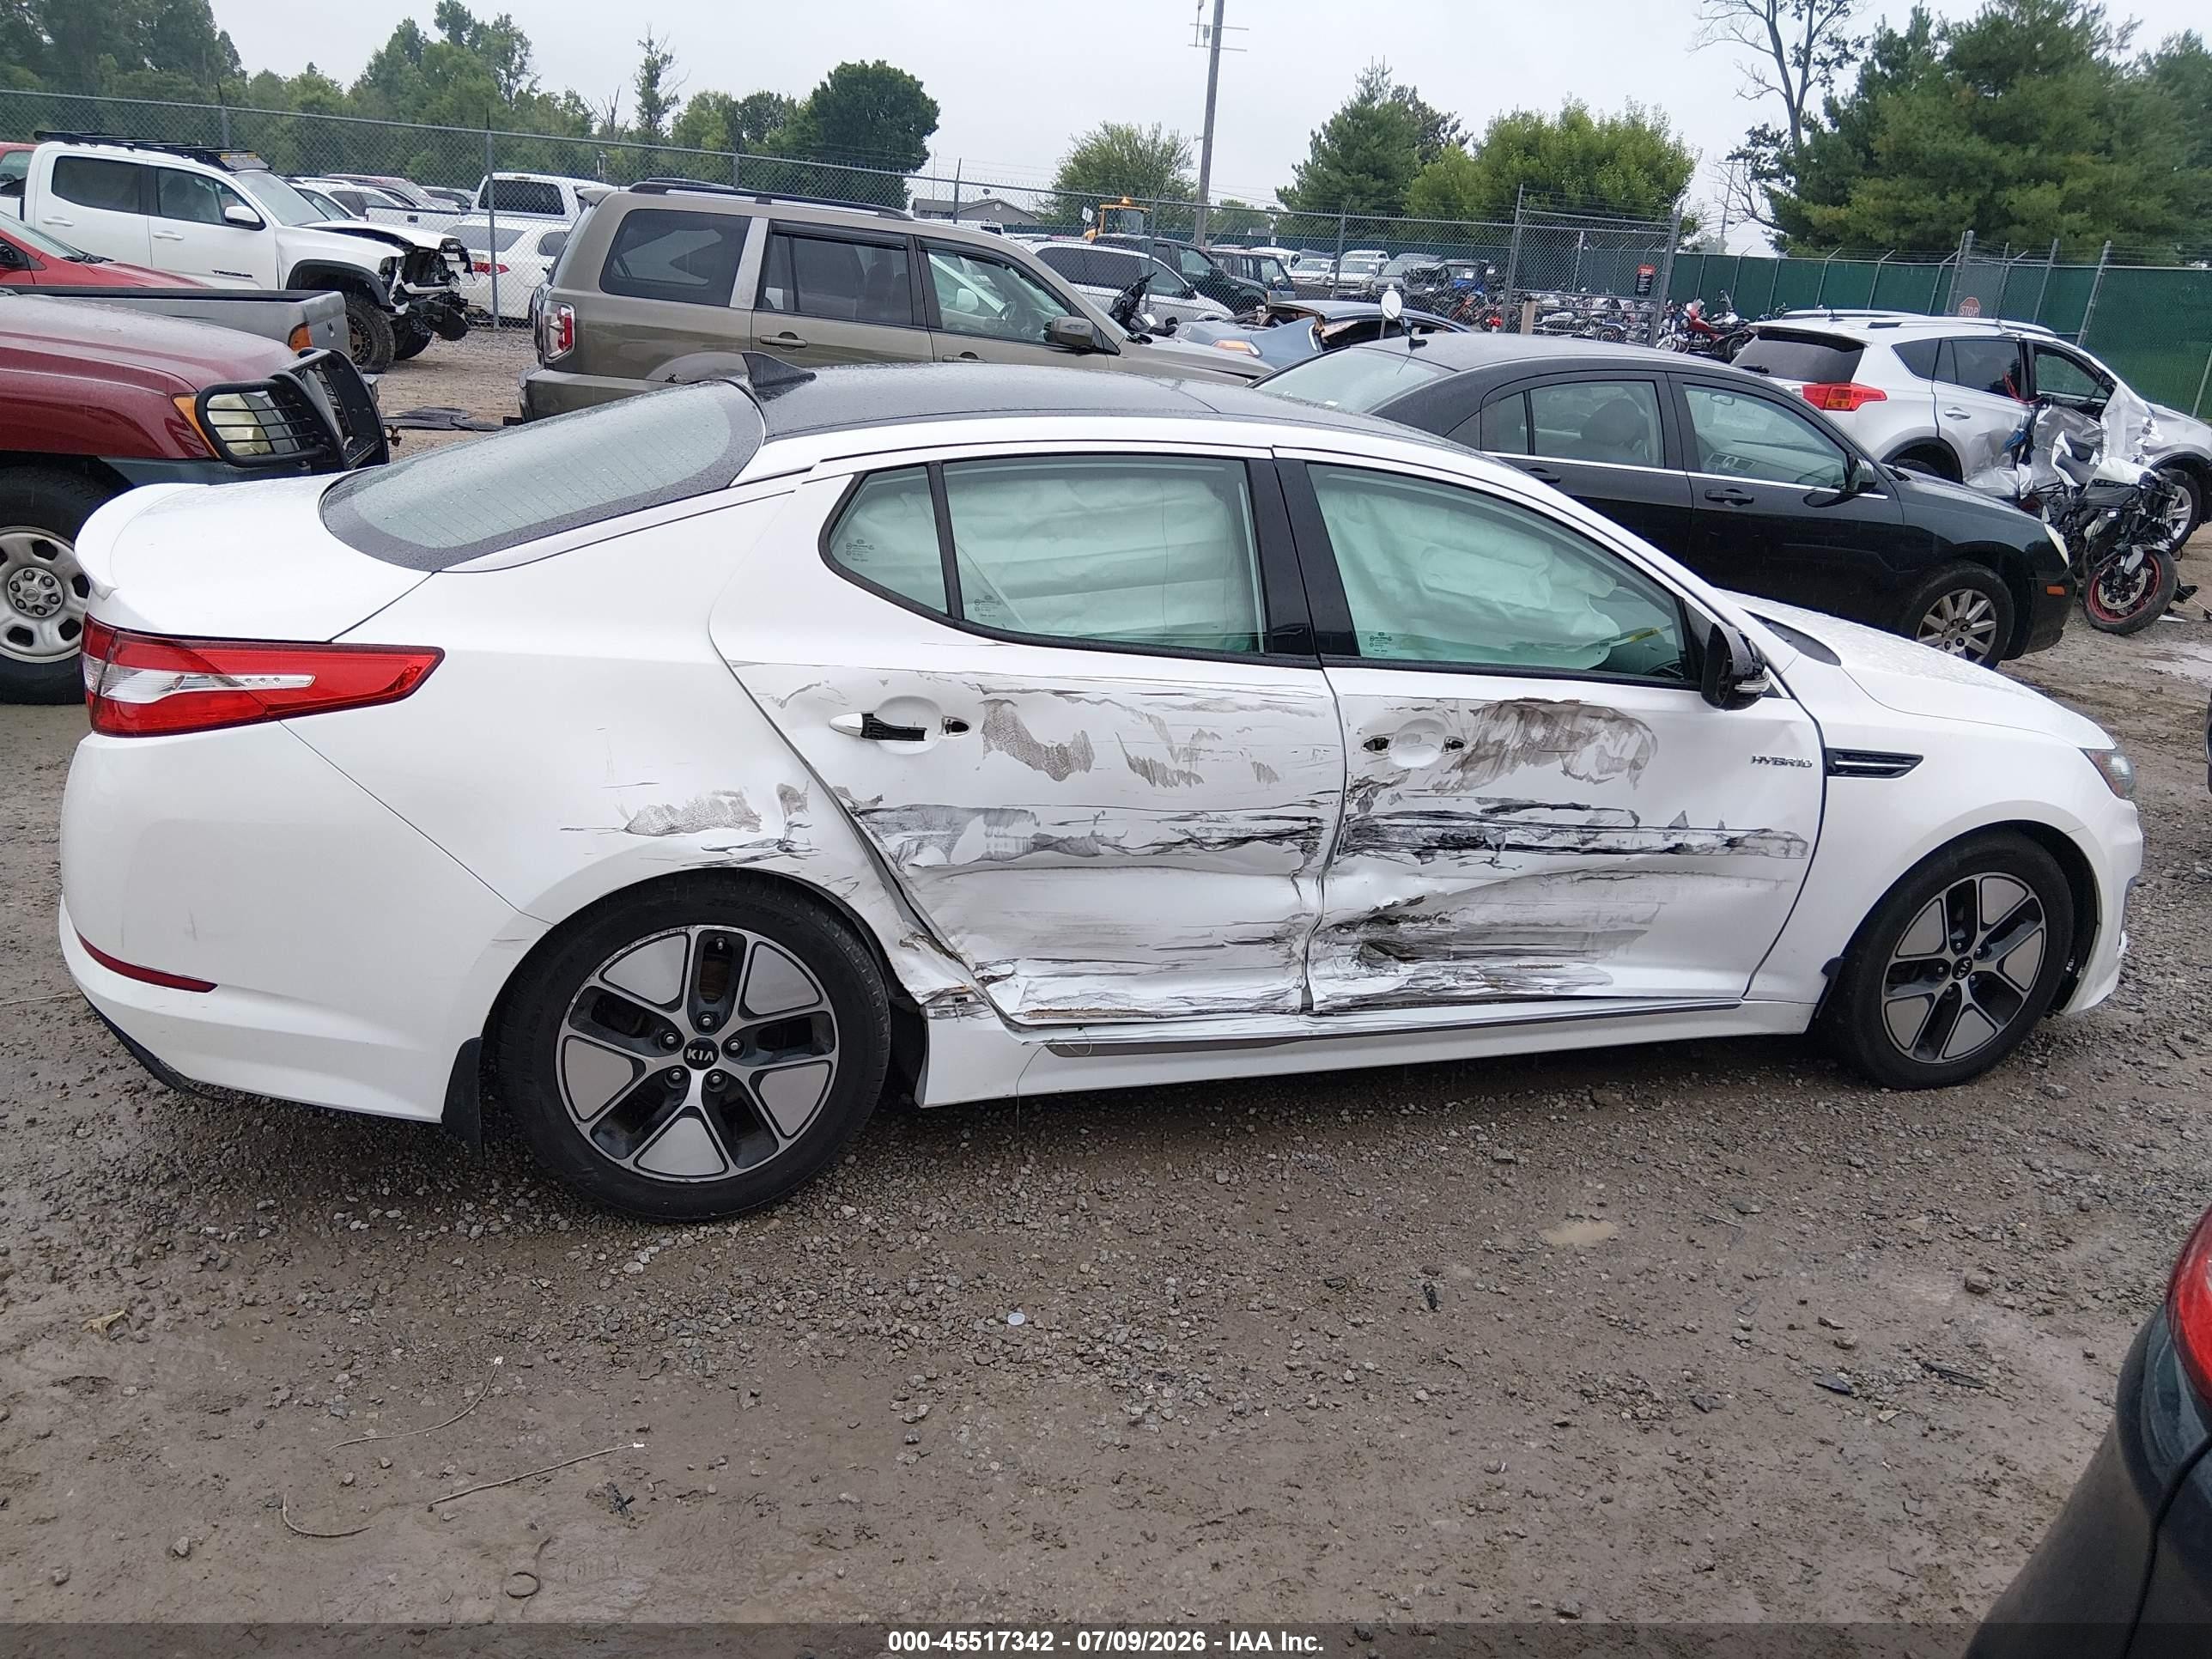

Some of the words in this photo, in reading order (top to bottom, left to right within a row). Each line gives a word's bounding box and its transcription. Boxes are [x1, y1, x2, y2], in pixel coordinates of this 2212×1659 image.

[211, 269, 253, 279] TACOMA
[1960, 306, 1979, 317] STOP
[1751, 755, 1813, 769] HYBRID
[1955, 960, 1971, 978] KIA
[686, 1048, 714, 1061] KIA
